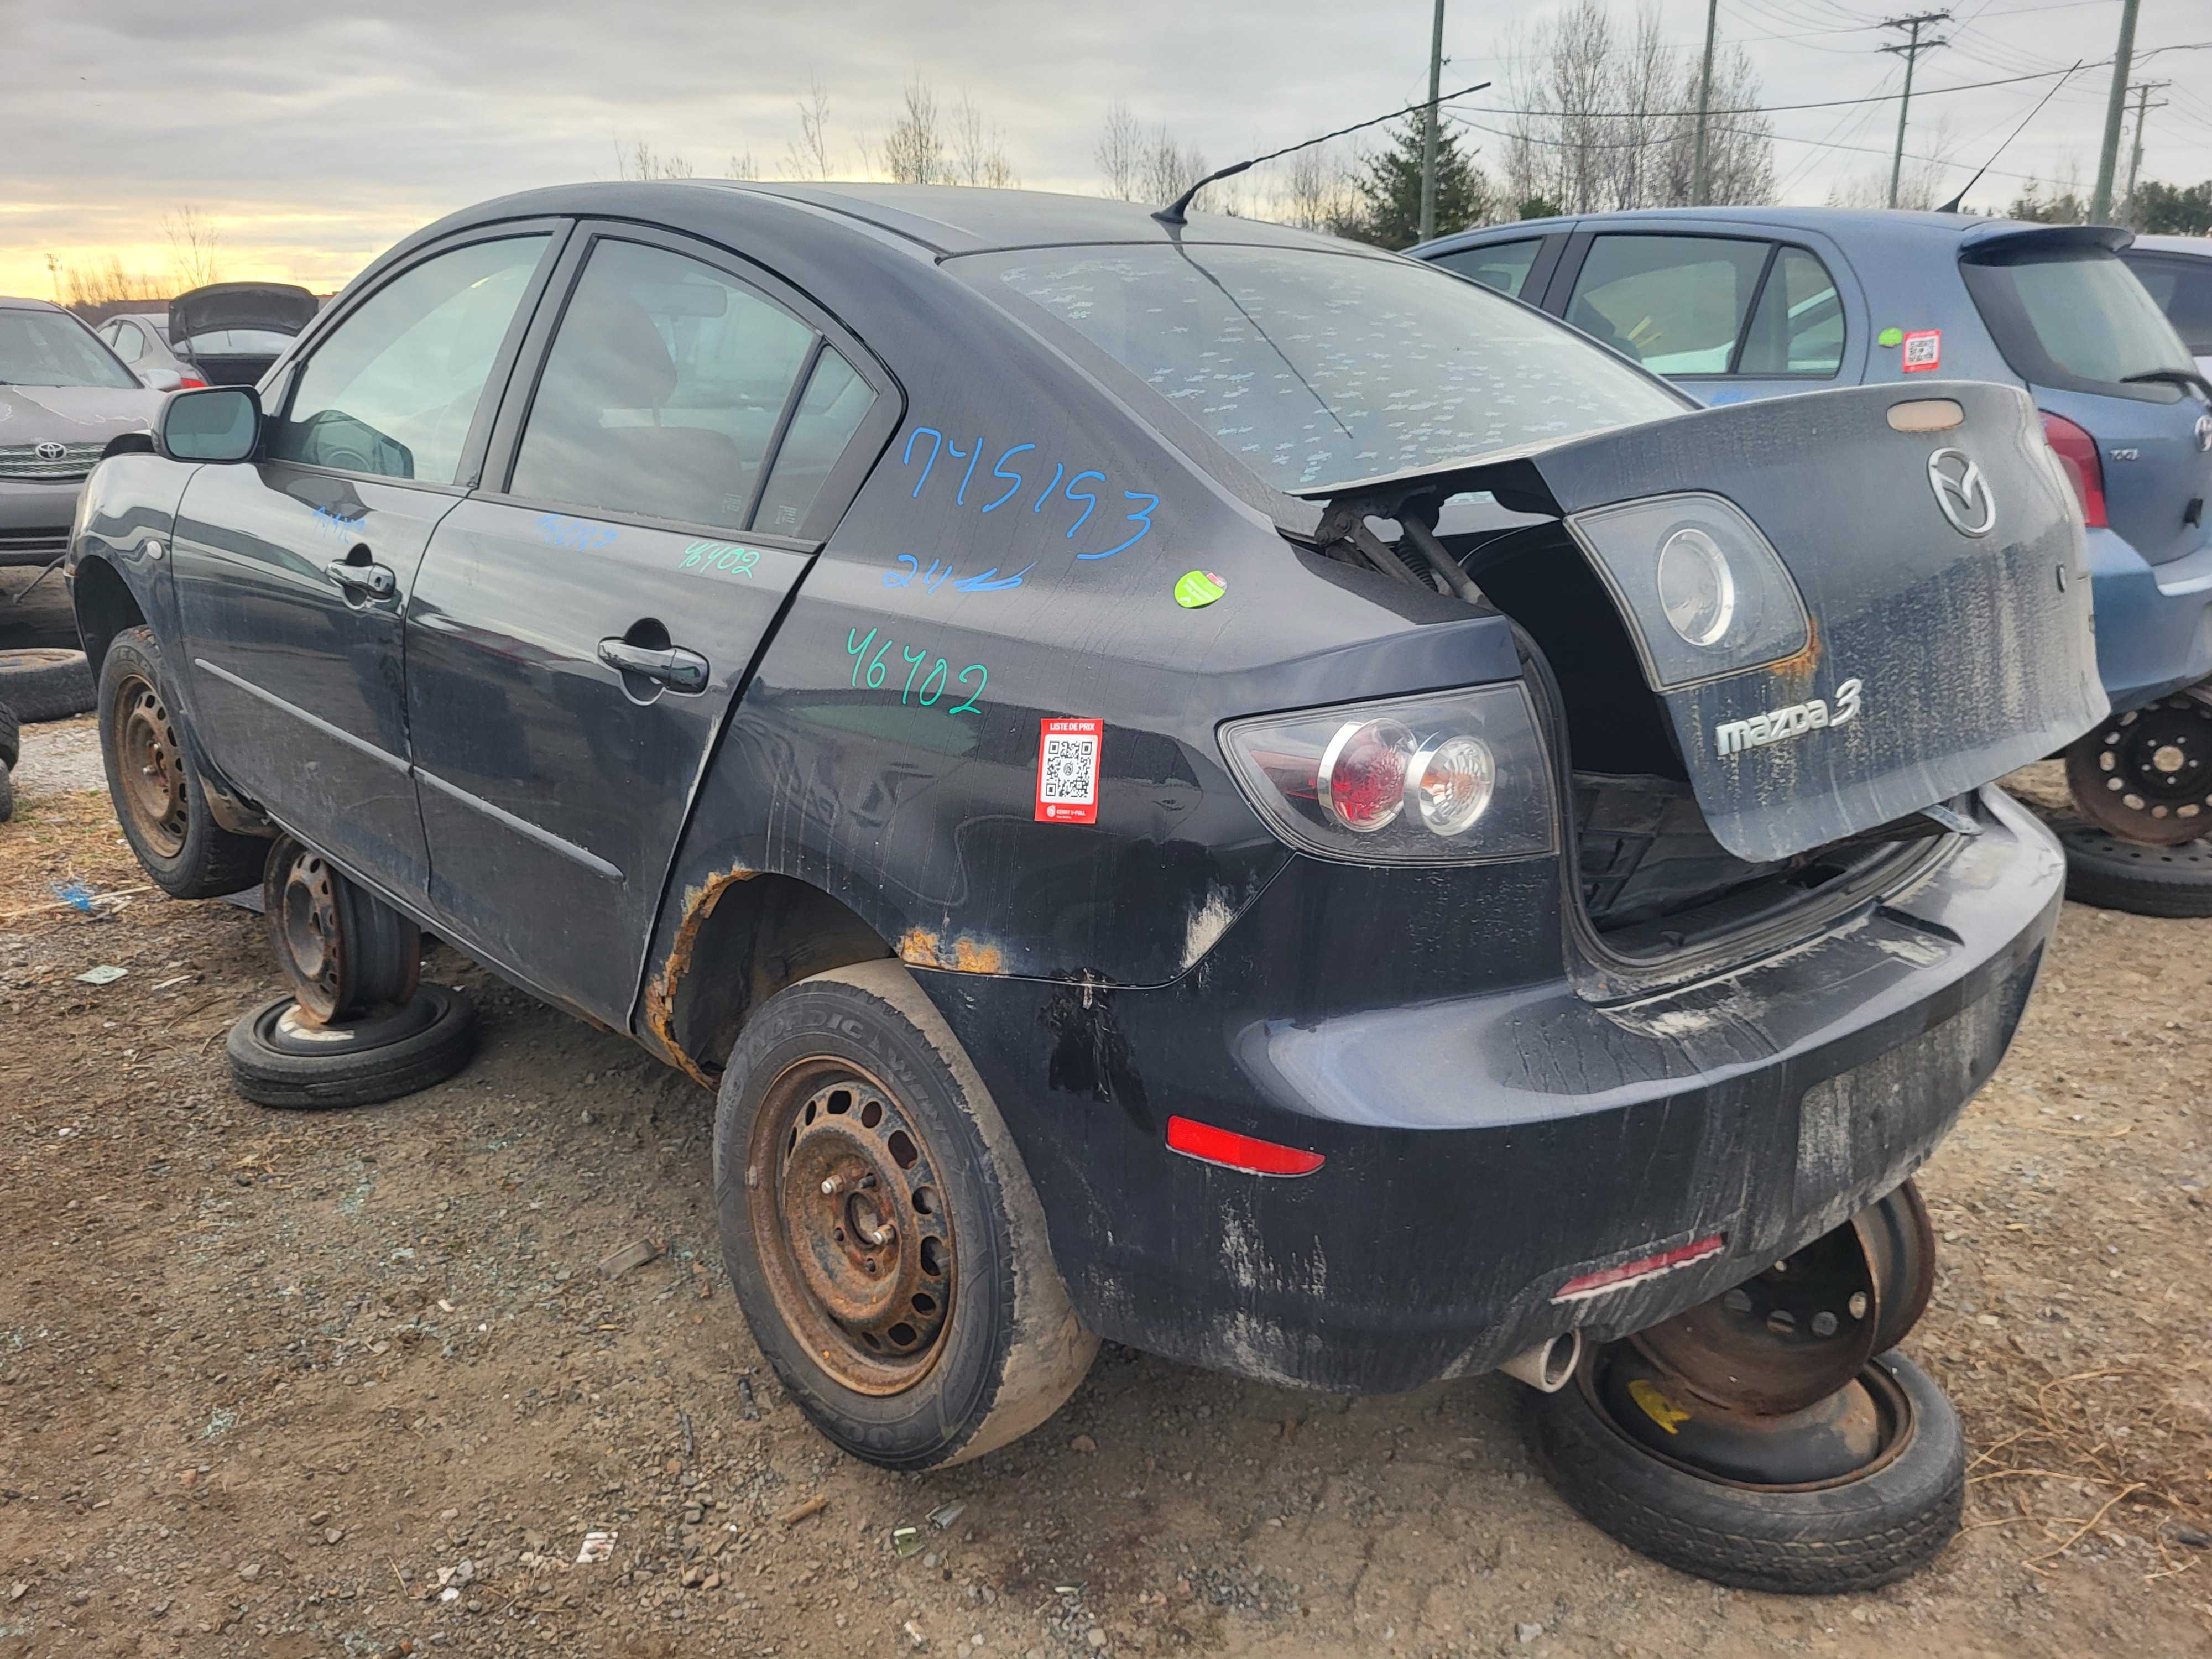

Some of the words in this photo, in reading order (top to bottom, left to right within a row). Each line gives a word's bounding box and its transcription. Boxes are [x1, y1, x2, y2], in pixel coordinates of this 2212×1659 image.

[847, 628, 988, 714] 46402
[1050, 722, 1068, 731] LISTE
[1068, 722, 1078, 731] DE
[1079, 723, 1095, 731] PRIX
